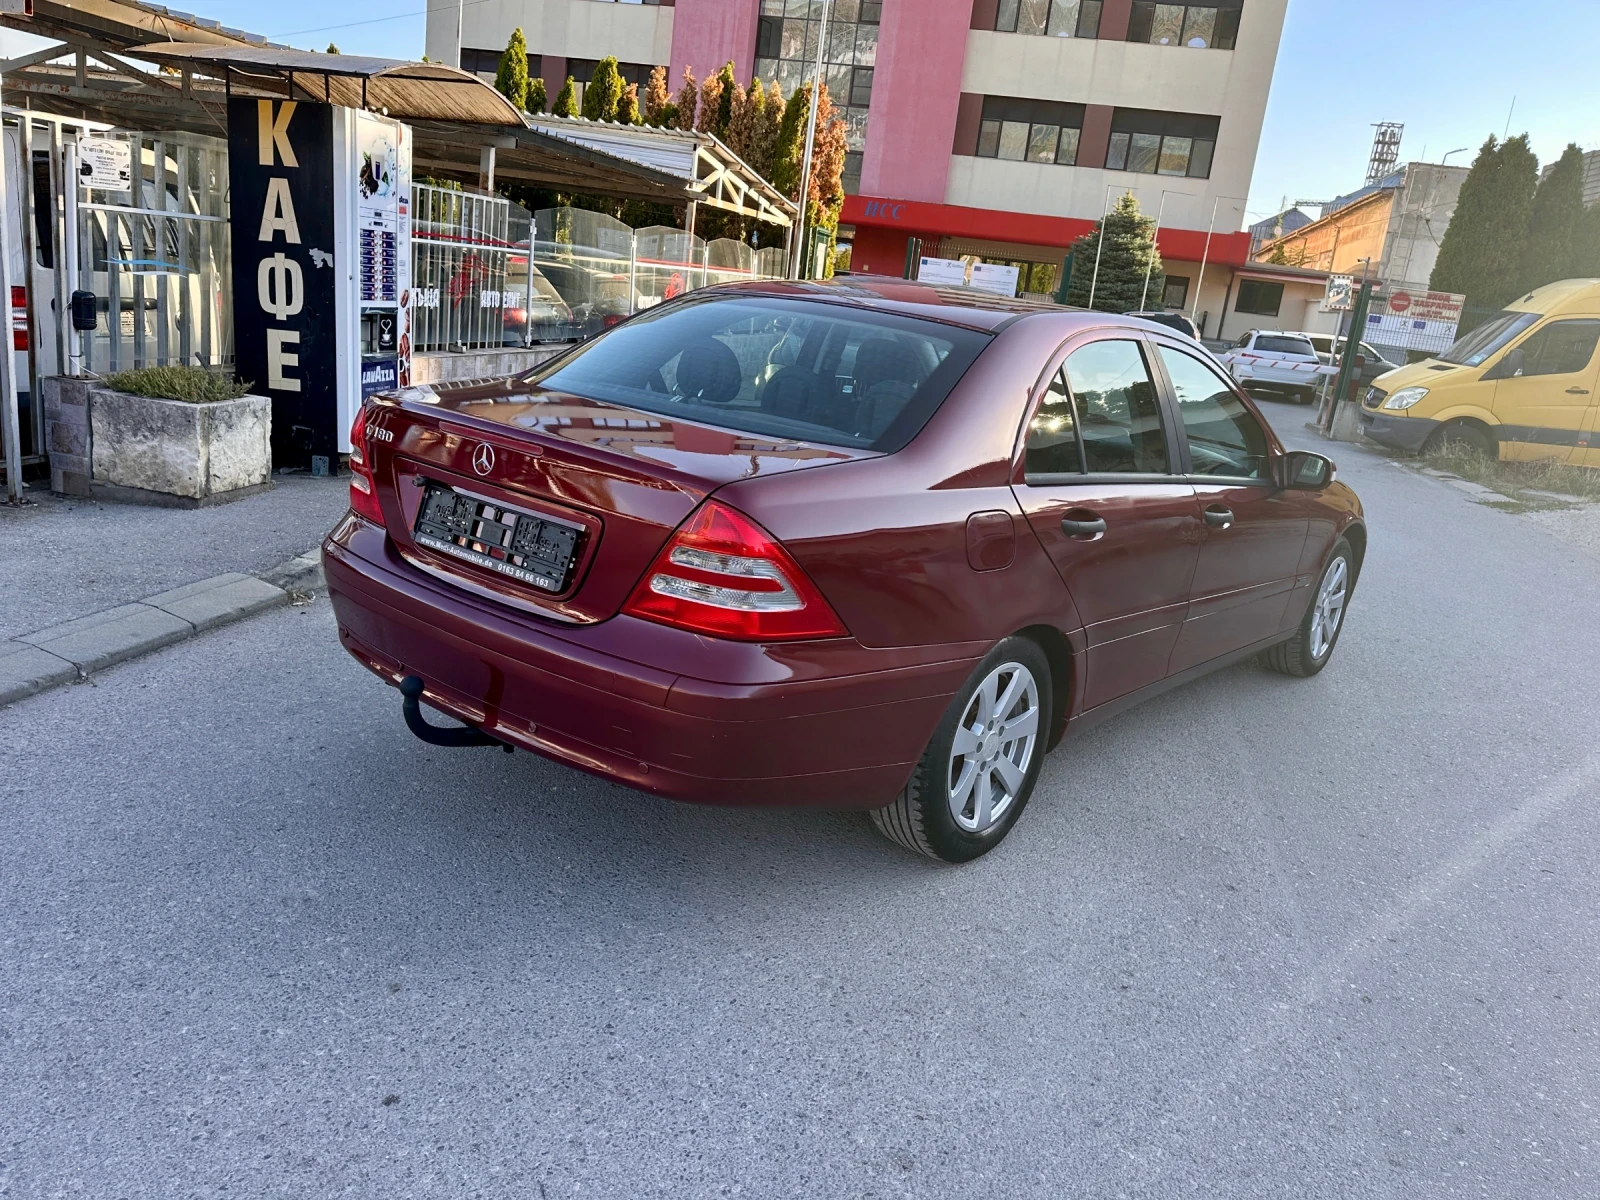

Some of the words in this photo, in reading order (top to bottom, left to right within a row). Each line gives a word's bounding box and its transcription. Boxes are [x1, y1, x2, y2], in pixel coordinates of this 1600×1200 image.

[257, 99, 304, 393] КАФЕ
[362, 365, 395, 384] LAVAZZA
[374, 426, 394, 442] 180
[498, 563, 514, 575] 0163
[515, 569, 525, 578] 84
[525, 573, 534, 582] 66
[536, 576, 549, 587] 163
